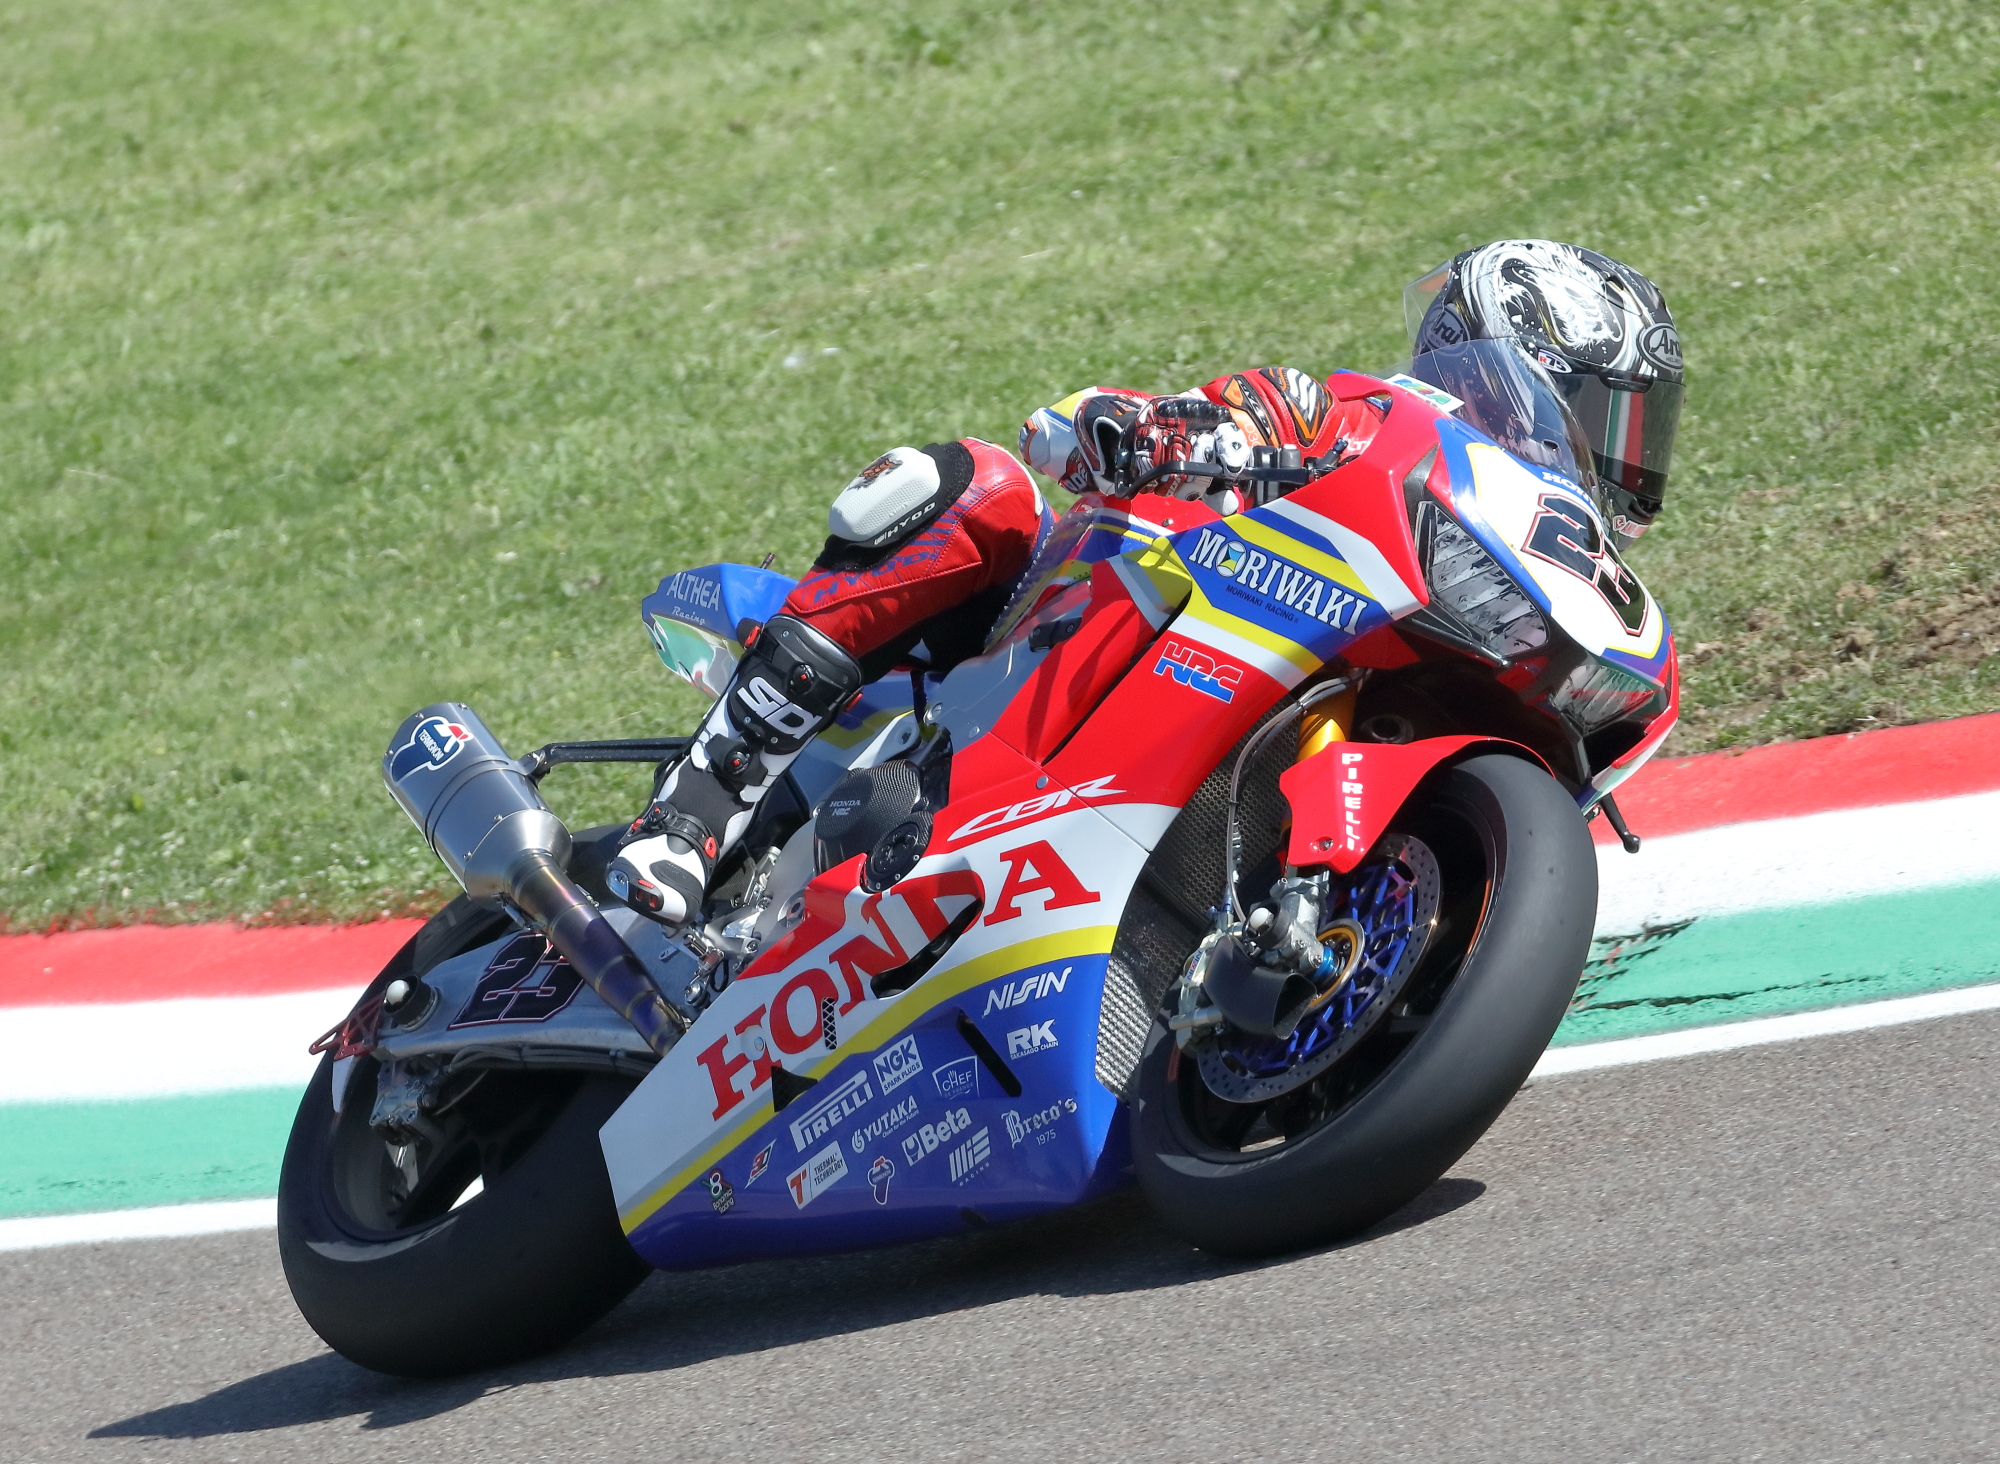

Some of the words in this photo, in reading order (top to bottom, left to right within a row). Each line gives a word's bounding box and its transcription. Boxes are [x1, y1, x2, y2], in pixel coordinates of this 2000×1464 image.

[887, 502, 936, 538] HYOD
[1188, 527, 1368, 636] MORIWAKI
[1521, 492, 1649, 638] 23
[666, 572, 722, 611] ALTHEA
[1225, 584, 1263, 608] MORIWAKI
[1265, 603, 1294, 622] RACING
[671, 605, 706, 625] Racing
[1153, 641, 1244, 705] HRC
[418, 728, 445, 762] TERMIGNONI
[829, 799, 861, 808] HONDA
[946, 773, 1128, 842] CBR
[1341, 752, 1364, 851] PIRELLI
[696, 840, 1101, 1121] HONDA
[1006, 1018, 1058, 1056] RK
[1040, 1040, 1060, 1051] CHAIN
[876, 1038, 917, 1083] NGK
[883, 1076, 902, 1092] SPARK
[901, 1061, 922, 1079] PLUGS
[942, 1069, 972, 1092] CHEF
[789, 1069, 875, 1154] PIRELLI
[863, 1095, 918, 1142] YUTAKA
[918, 1107, 973, 1154] Beta
[1001, 1096, 1078, 1149] Breco's
[1036, 1130, 1057, 1147] 1975
[813, 1152, 838, 1176] THERMAL
[813, 1157, 844, 1186] TECHNOLOGY
